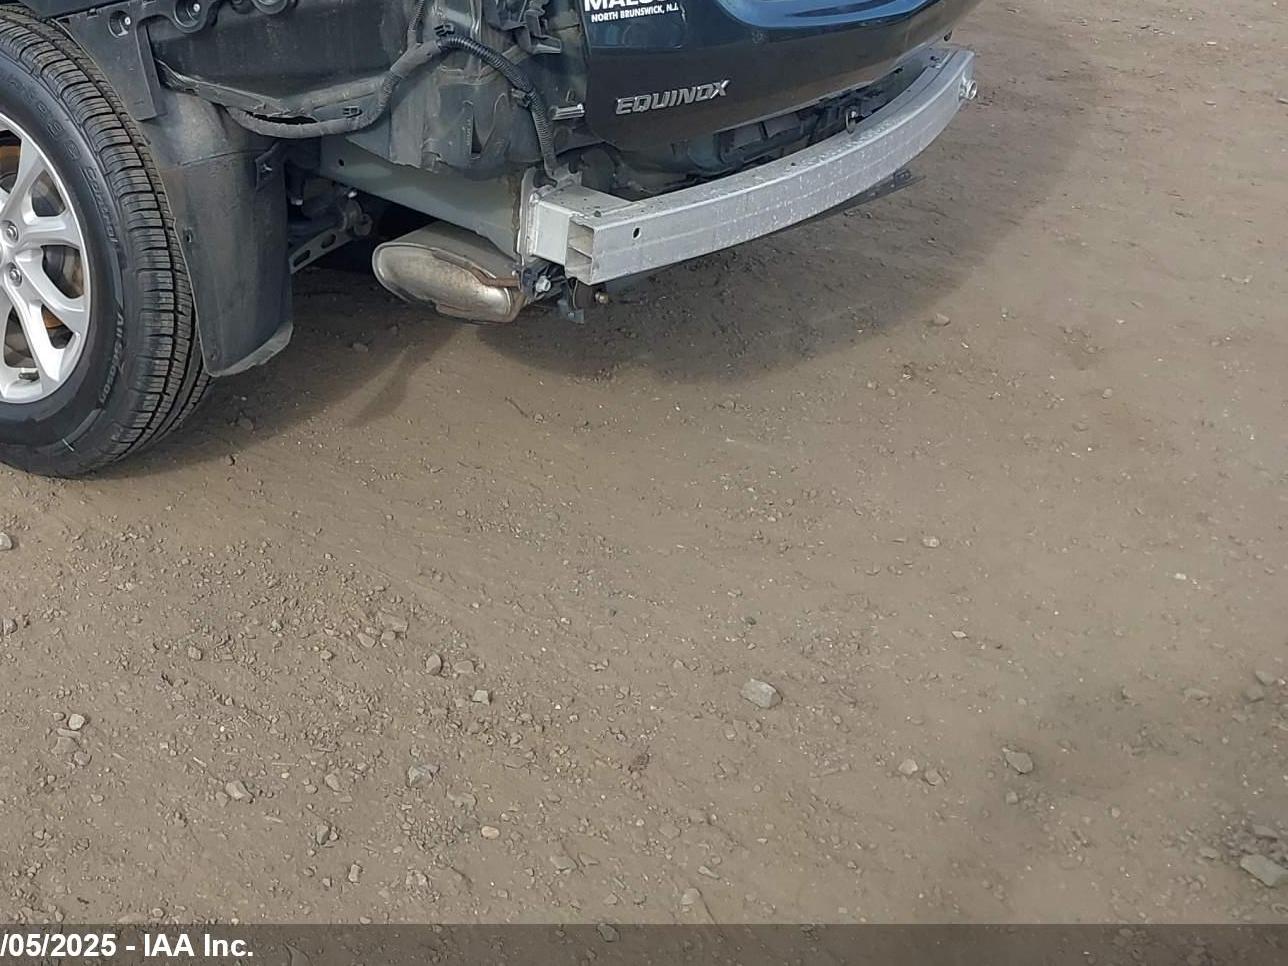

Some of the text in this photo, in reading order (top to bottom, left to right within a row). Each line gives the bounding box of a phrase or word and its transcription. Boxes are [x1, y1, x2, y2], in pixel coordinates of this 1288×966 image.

[591, 11, 619, 23] NORTH
[620, 4, 666, 19] BRUNSWICK,
[615, 79, 731, 115] EQUINOX
